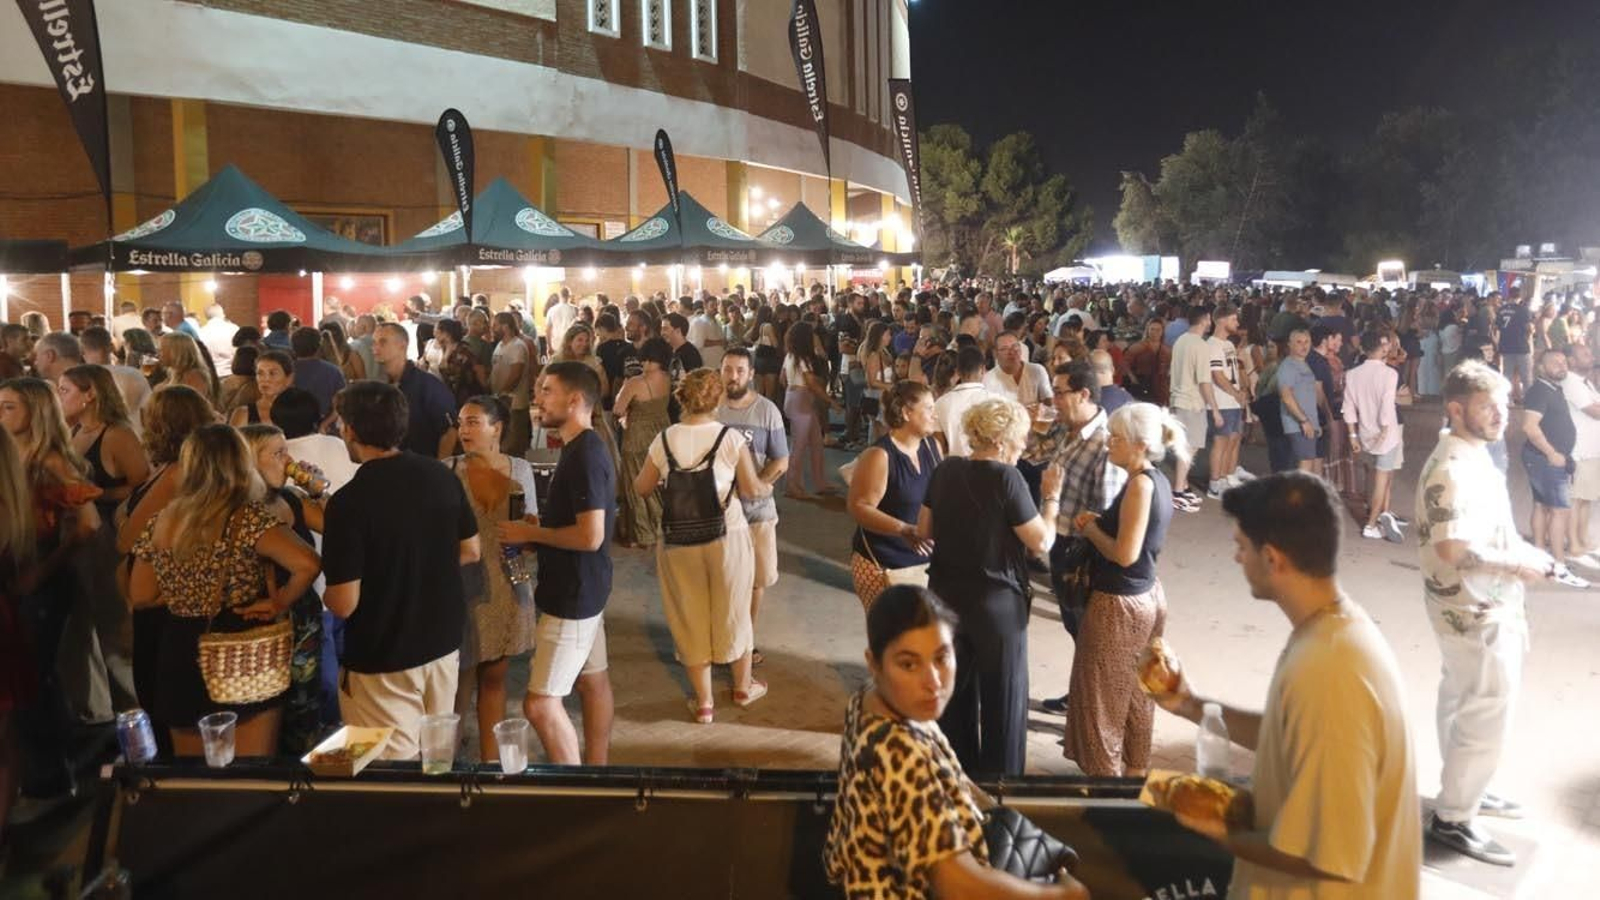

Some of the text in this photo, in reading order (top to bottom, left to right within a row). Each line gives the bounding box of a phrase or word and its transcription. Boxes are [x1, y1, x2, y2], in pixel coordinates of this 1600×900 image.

[128, 249, 241, 267] Estrella Galicia
[479, 248, 547, 261] Estrella Galicia
